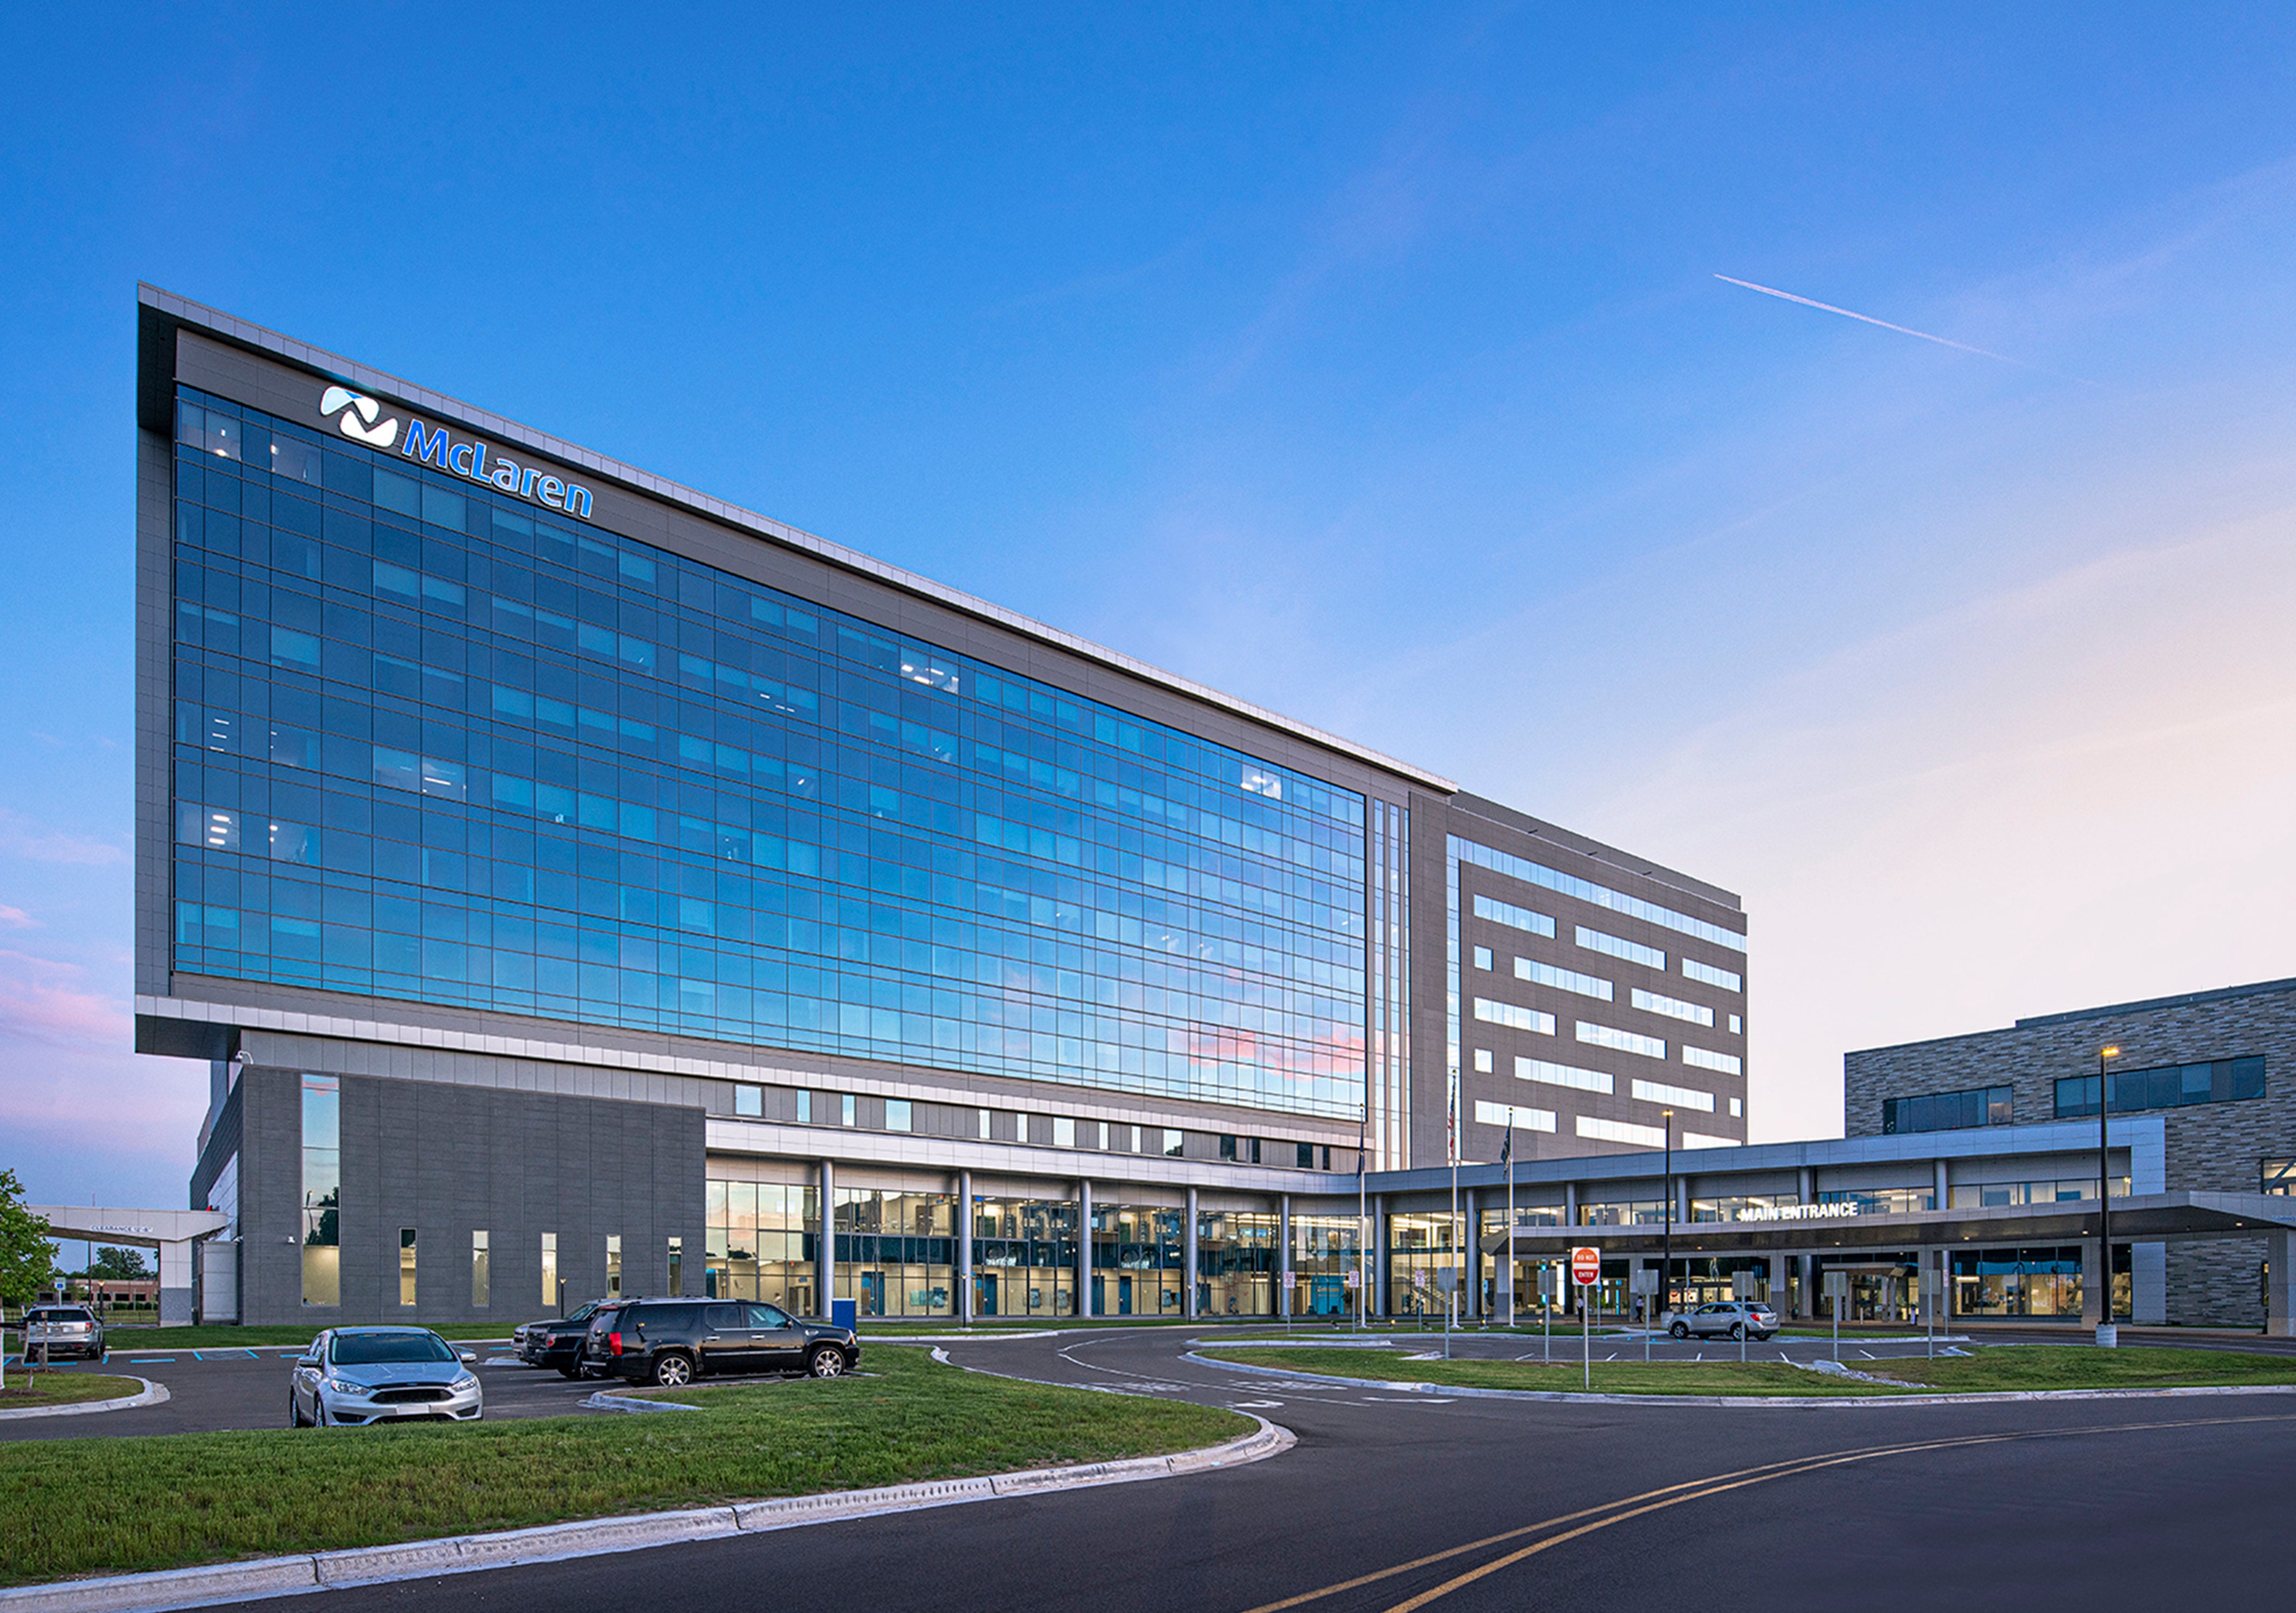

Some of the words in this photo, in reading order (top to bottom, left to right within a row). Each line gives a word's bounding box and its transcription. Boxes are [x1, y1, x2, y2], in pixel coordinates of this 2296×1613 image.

[401, 418, 594, 519] McLaren
[1739, 1206, 1779, 1222] MAIN
[1781, 1202, 1858, 1220] ENTRANCE
